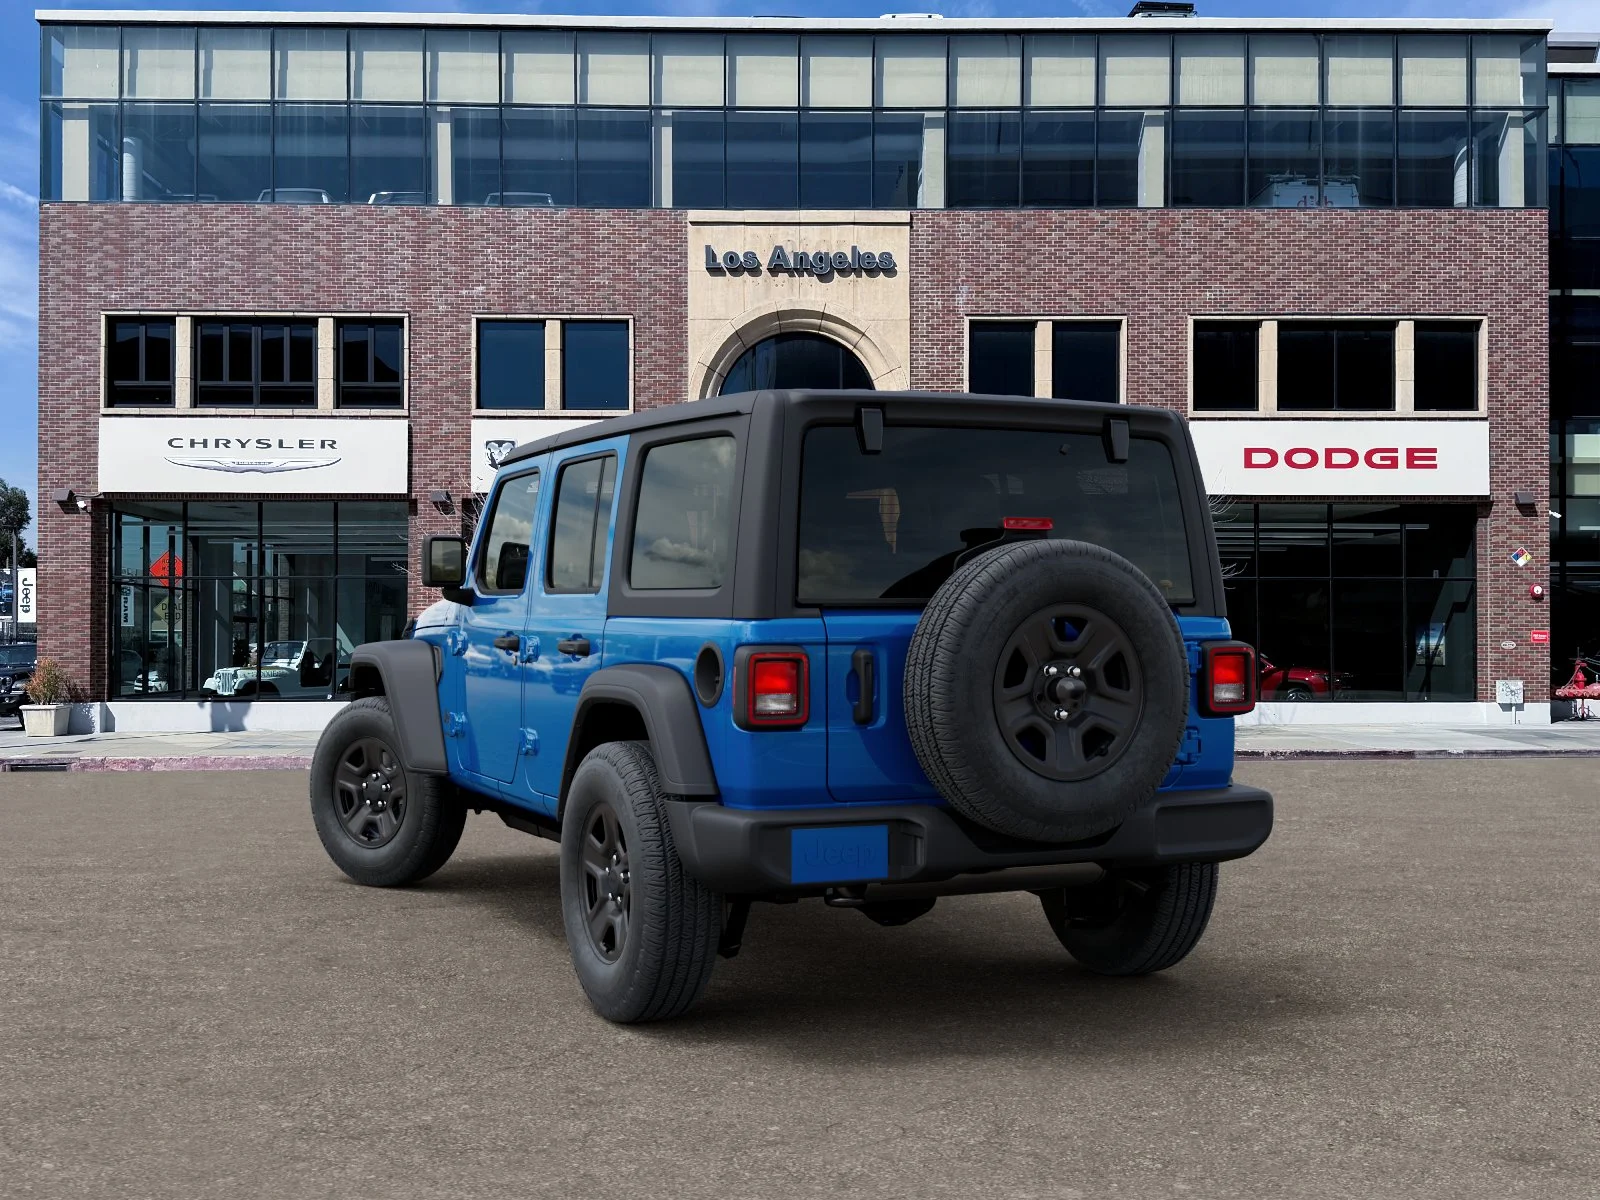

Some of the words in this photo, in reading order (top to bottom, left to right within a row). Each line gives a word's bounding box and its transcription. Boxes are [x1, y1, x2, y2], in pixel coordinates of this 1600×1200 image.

[705, 244, 758, 270] Los
[766, 244, 894, 275] Angeles
[167, 437, 338, 450] CHRYSLER
[1243, 447, 1438, 470] DODGE
[19, 577, 33, 613] Jeep
[161, 602, 183, 611] DAD
[164, 612, 181, 620] ED
[804, 836, 876, 868] Jeep
